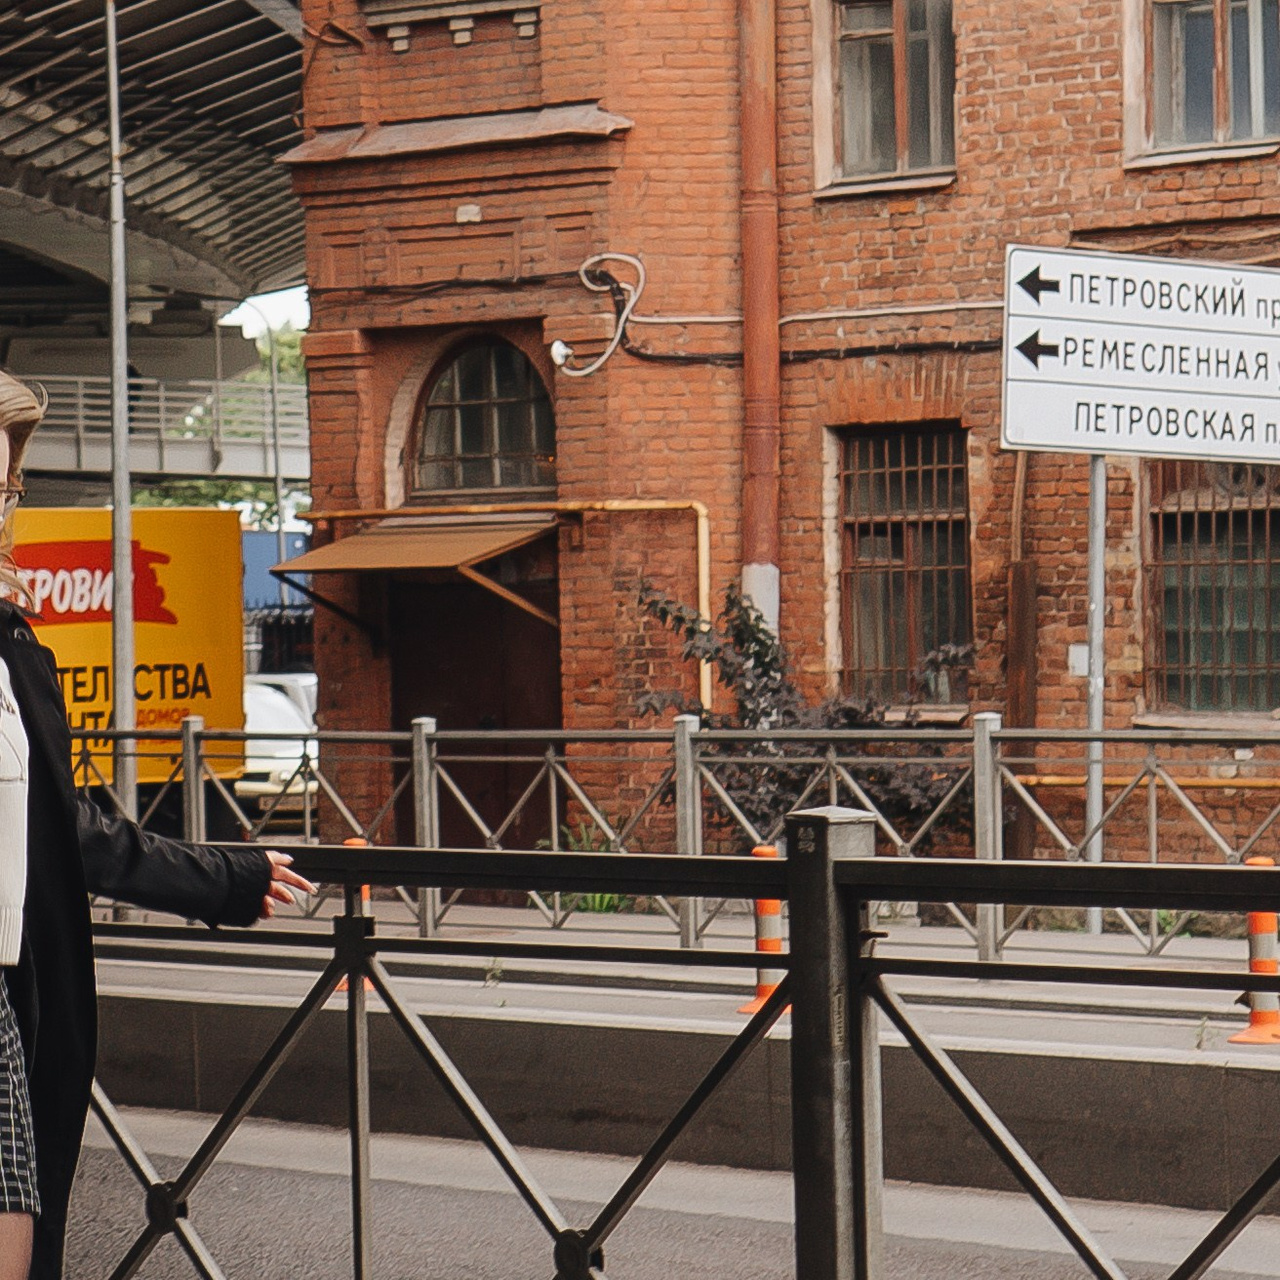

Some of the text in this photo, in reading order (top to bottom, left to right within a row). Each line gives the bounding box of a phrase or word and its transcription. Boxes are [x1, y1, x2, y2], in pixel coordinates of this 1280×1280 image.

[1069, 273, 1246, 317] ПЕТРОВСКИЙ
[1063, 336, 1269, 381] РЕМЕСЛЕННАЯ
[1074, 402, 1280, 444] ПЕТРОВСКАЯ п
